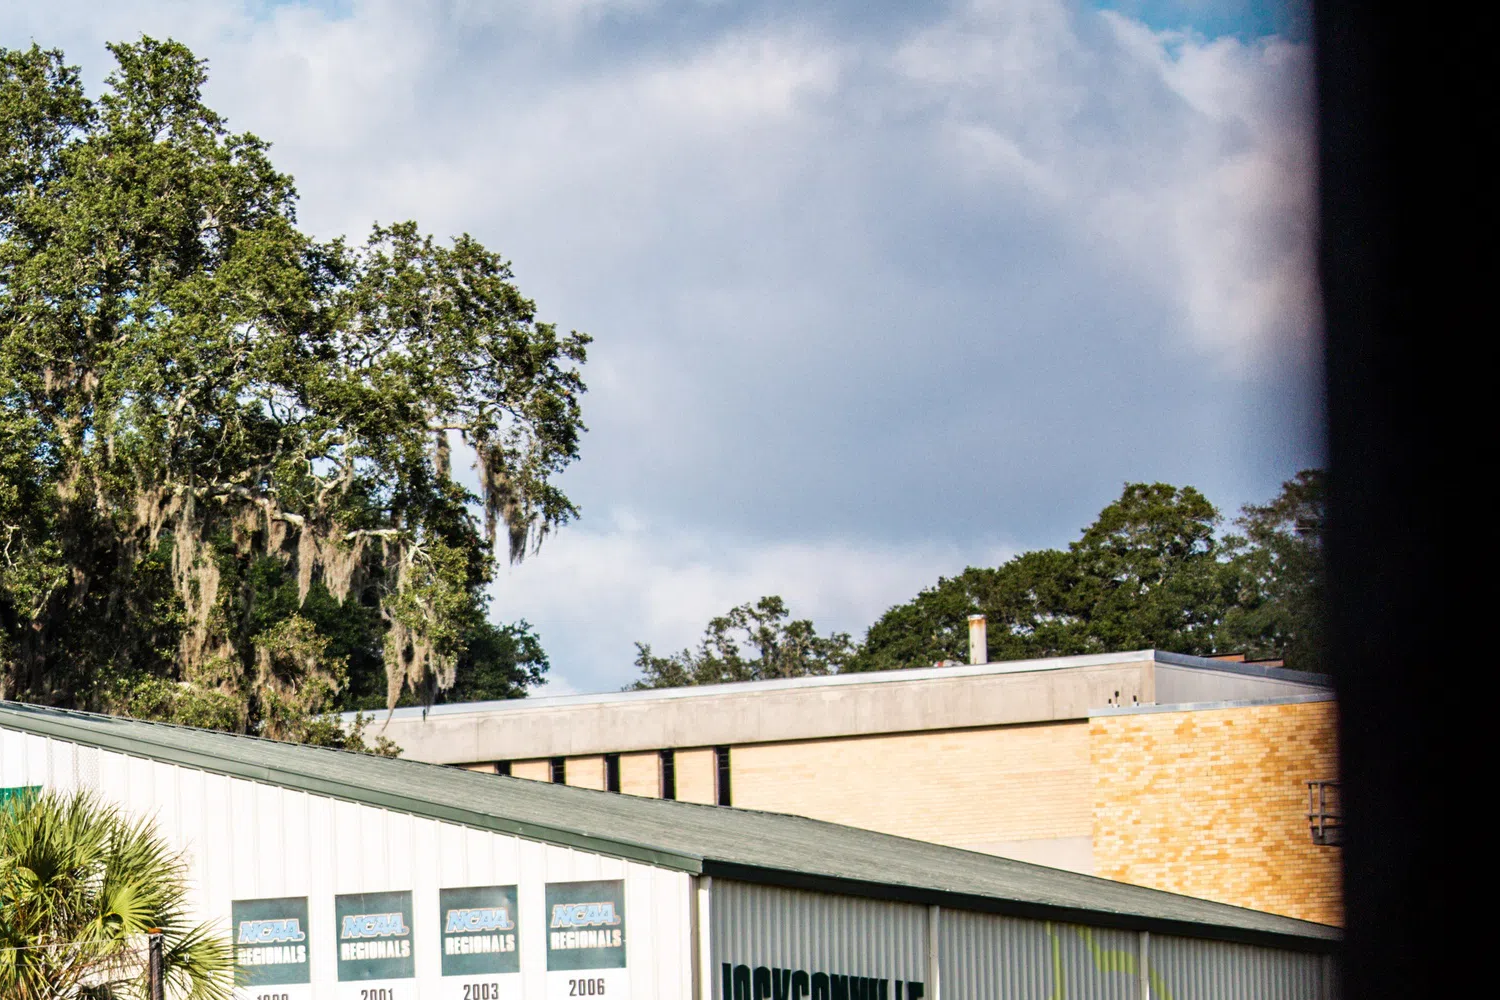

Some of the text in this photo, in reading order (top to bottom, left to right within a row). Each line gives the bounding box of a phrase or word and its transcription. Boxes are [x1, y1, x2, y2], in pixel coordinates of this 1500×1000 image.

[445, 934, 515, 955] REGIONALS
[550, 929, 621, 950] REGIONALS
[340, 940, 410, 961] REGIONALS
[463, 983, 499, 1000] 2003
[569, 978, 605, 996] 2006
